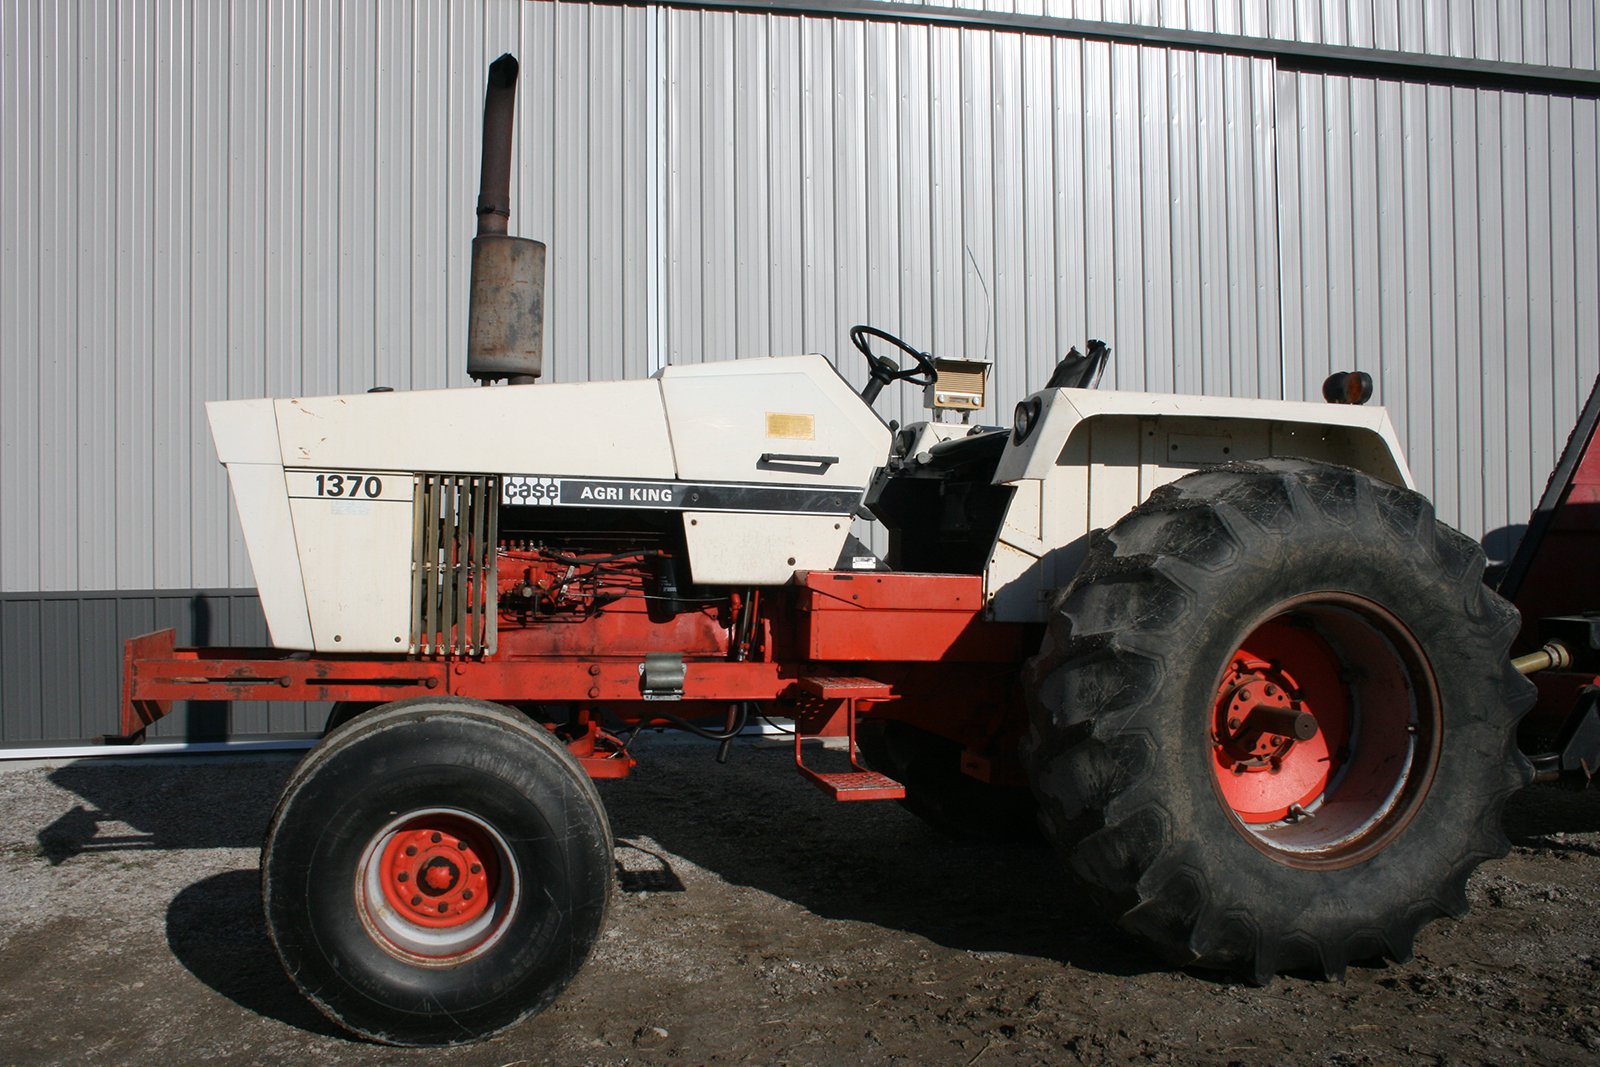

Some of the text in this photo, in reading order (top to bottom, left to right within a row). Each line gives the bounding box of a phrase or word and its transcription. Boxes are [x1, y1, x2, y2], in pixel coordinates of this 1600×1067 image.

[316, 474, 382, 498] 1370
[580, 486, 673, 502] AGRI KING
